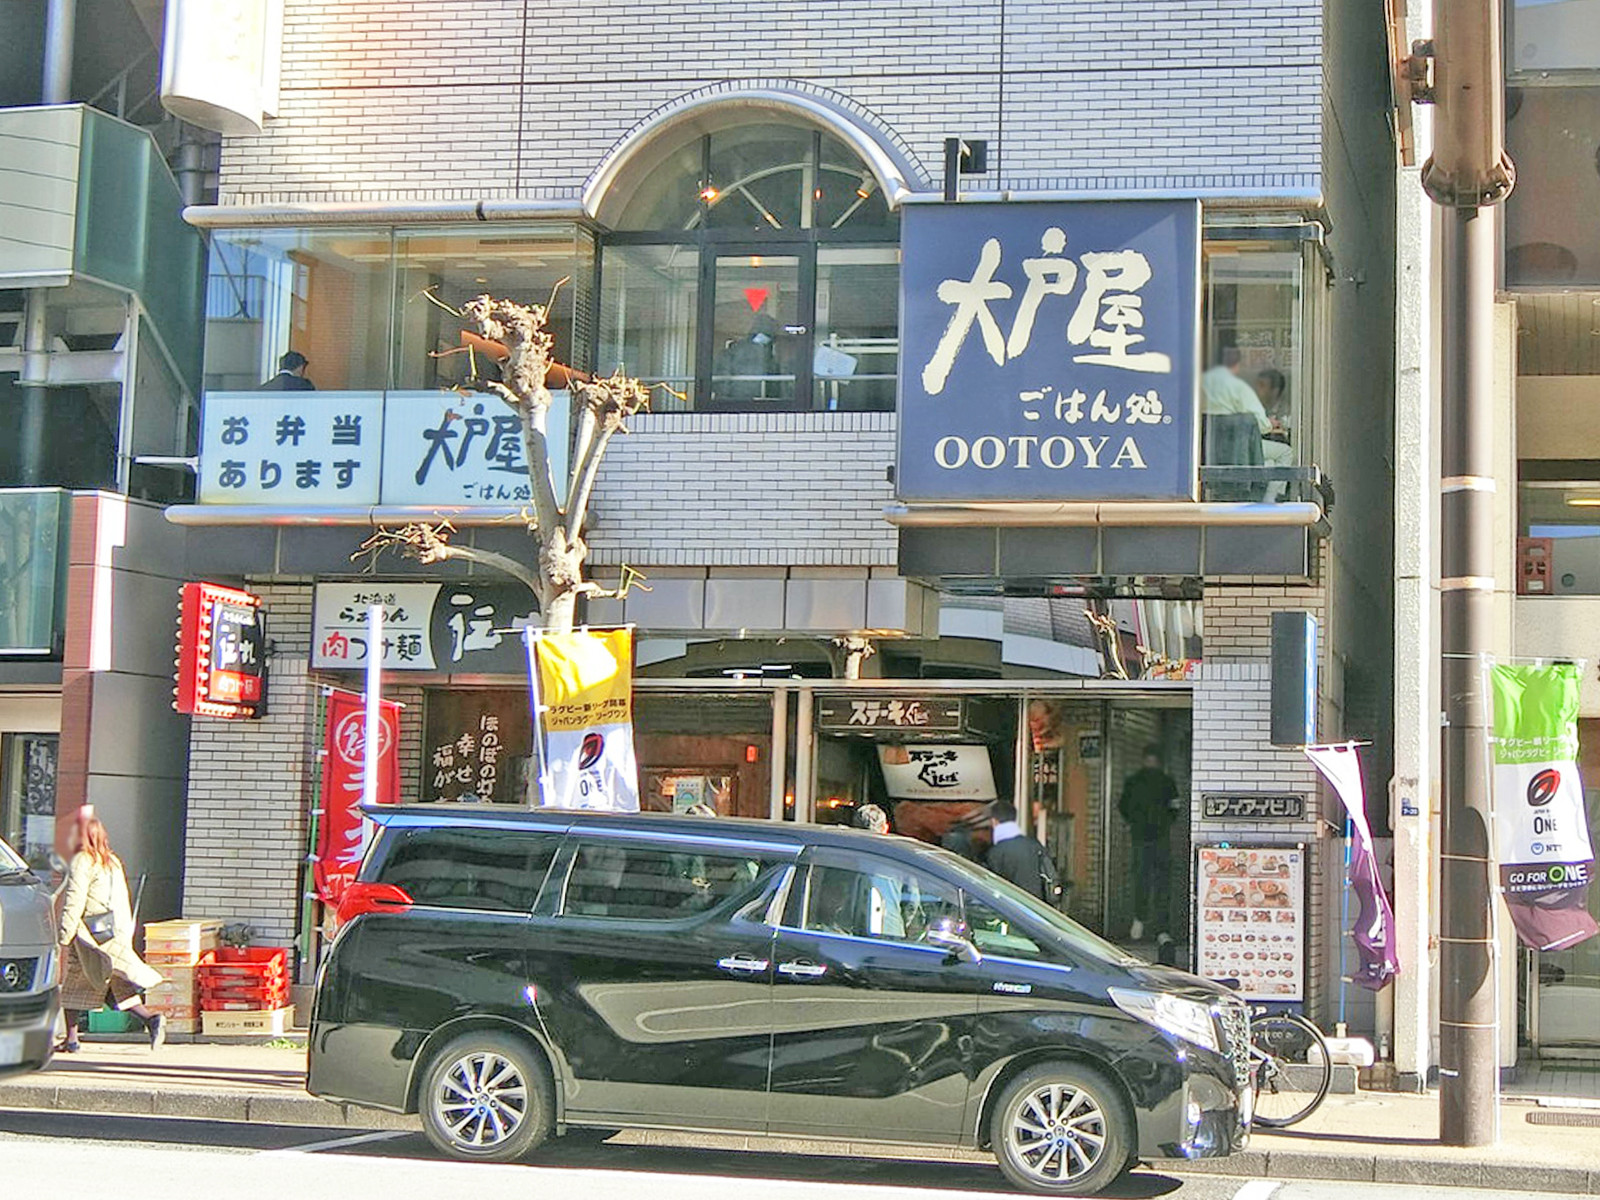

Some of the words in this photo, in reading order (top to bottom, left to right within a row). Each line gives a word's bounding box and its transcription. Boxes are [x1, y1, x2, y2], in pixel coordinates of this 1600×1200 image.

[921, 227, 1171, 395] 大戸屋
[1019, 386, 1164, 425] ごはん処
[221, 413, 362, 447] お弁当
[415, 403, 530, 486] 大戸屋
[933, 435, 1148, 470] OOTOYA
[217, 458, 362, 490] あります
[1533, 815, 1558, 835] ONE
[1509, 872, 1525, 883] GO
[1526, 871, 1547, 883] FOR
[1548, 864, 1588, 882] ONE
